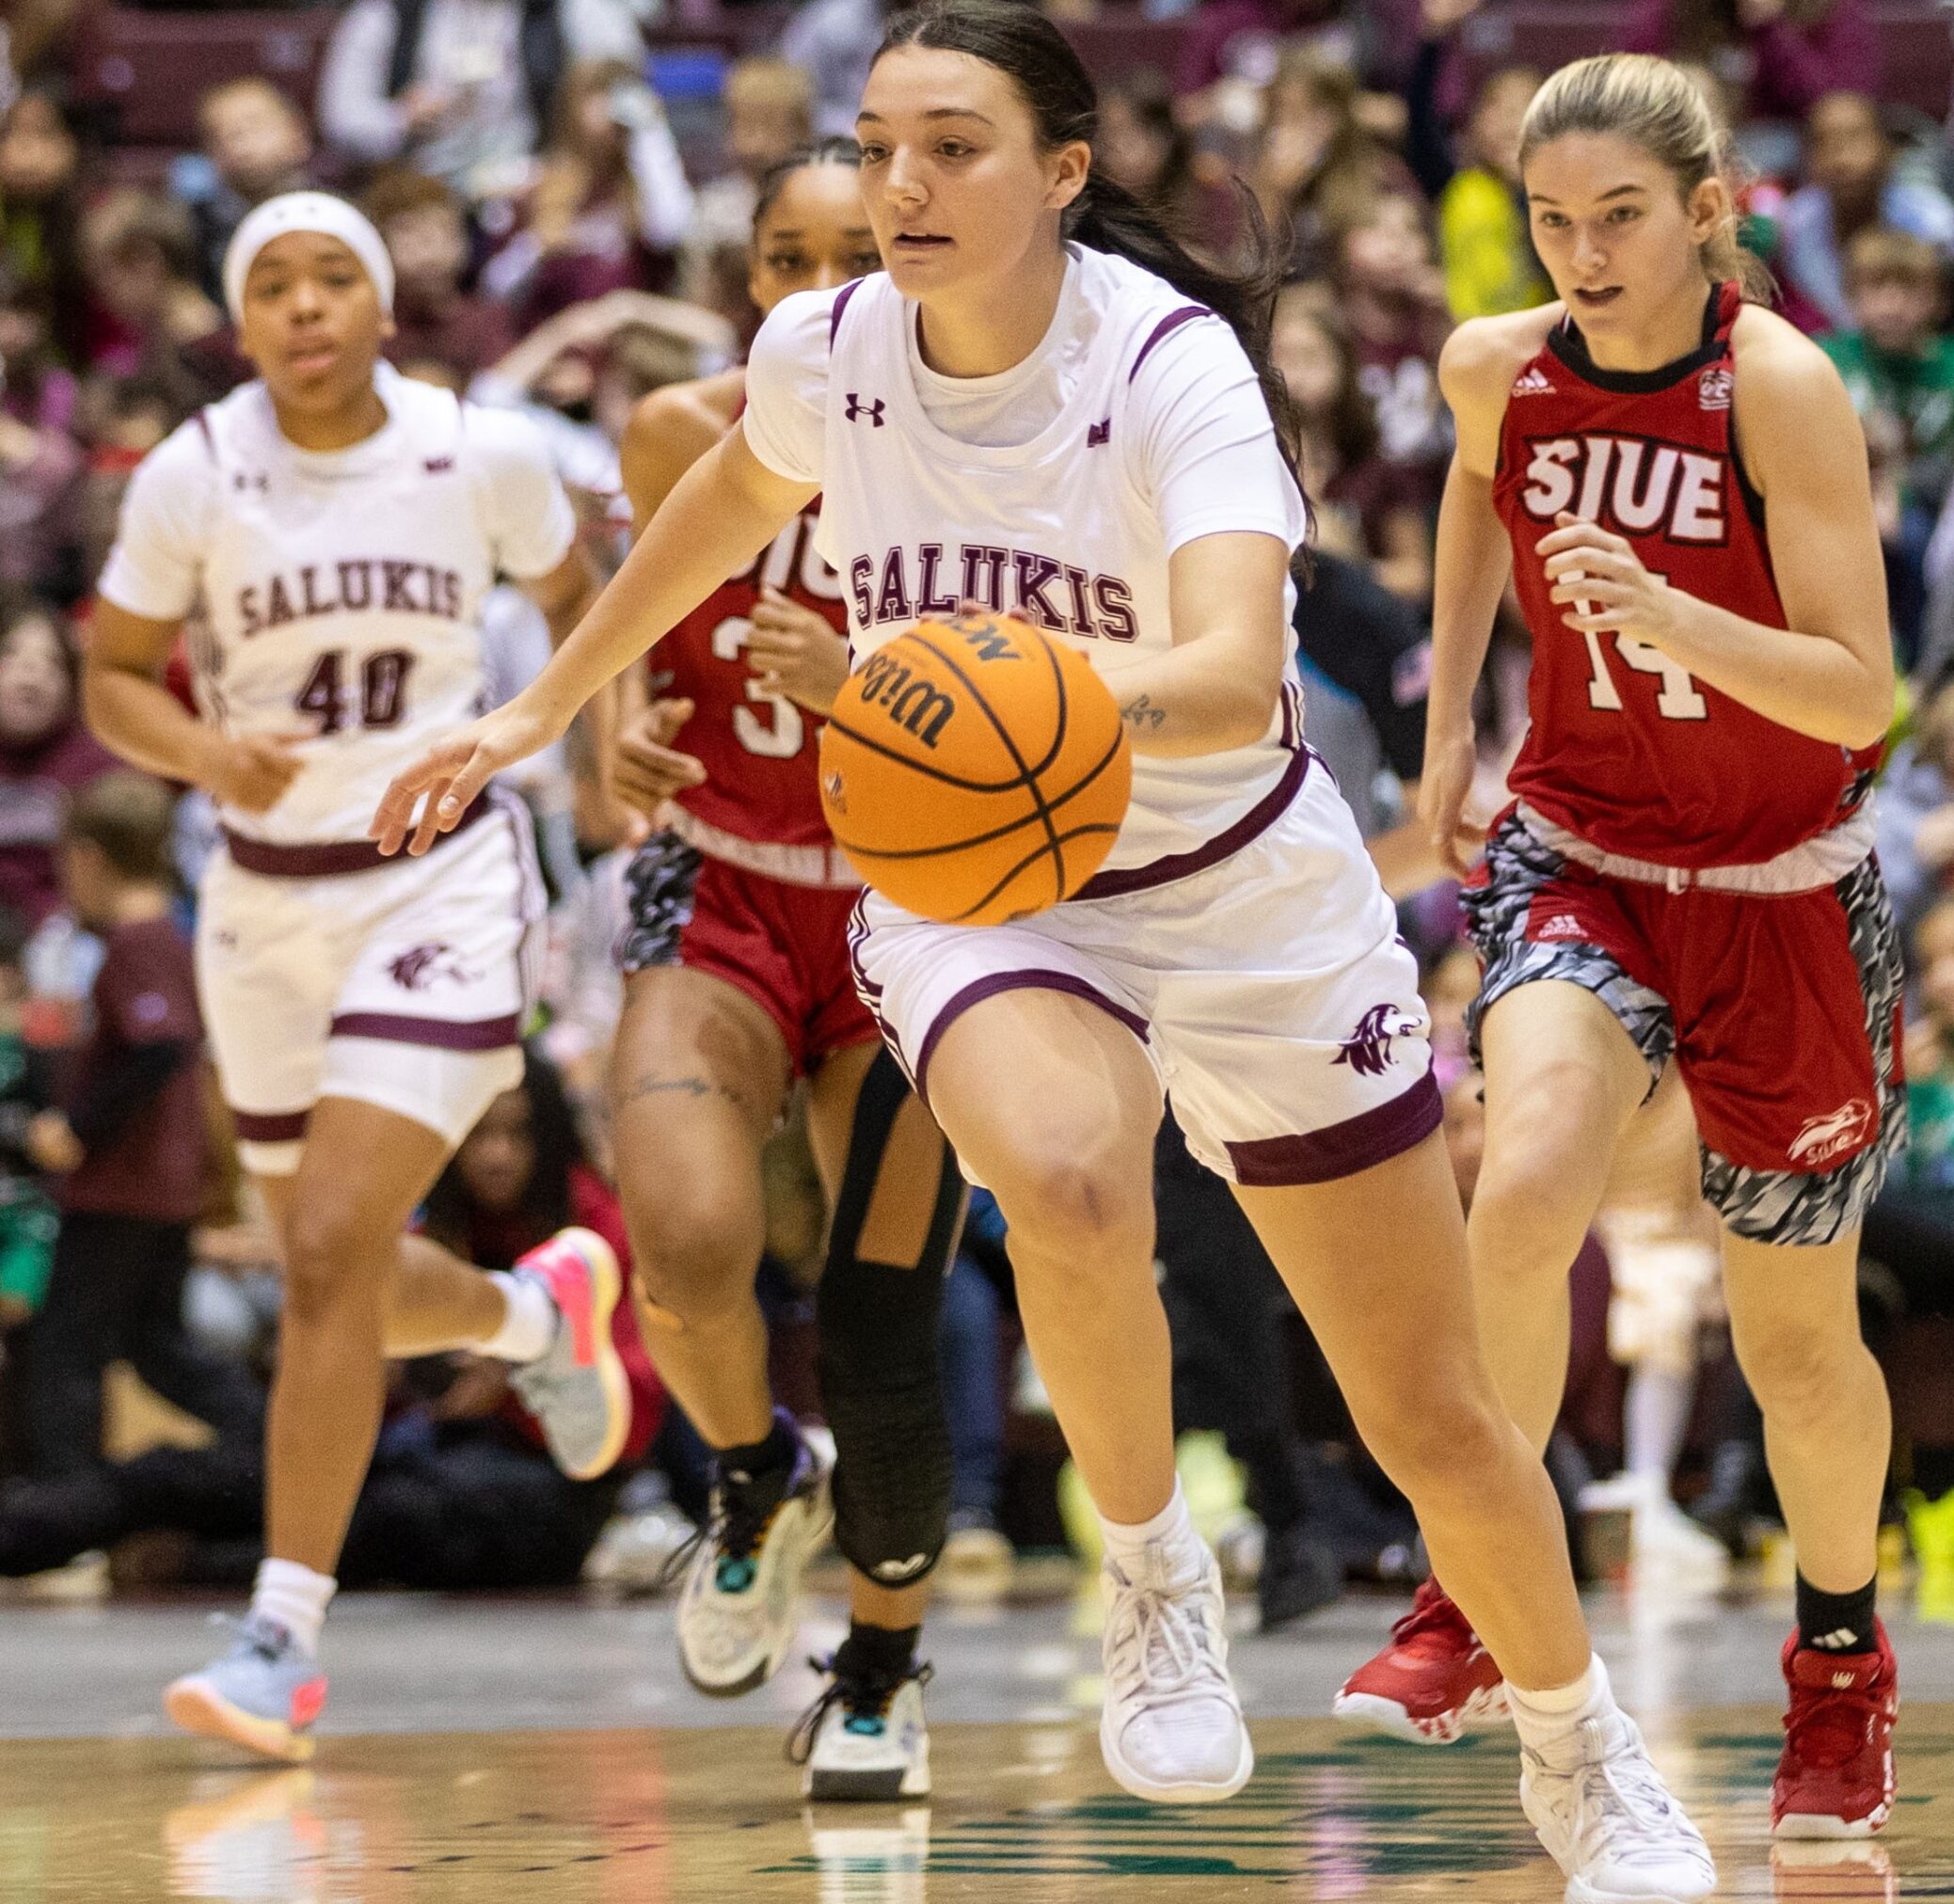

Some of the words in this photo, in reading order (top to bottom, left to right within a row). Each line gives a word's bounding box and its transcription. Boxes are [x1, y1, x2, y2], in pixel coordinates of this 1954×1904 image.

[1519, 434, 1727, 544] SIUE
[237, 560, 462, 641] SALUKIS
[850, 543, 1140, 643] SALUKIS
[294, 646, 419, 735] 40
[855, 651, 955, 750] Wils
